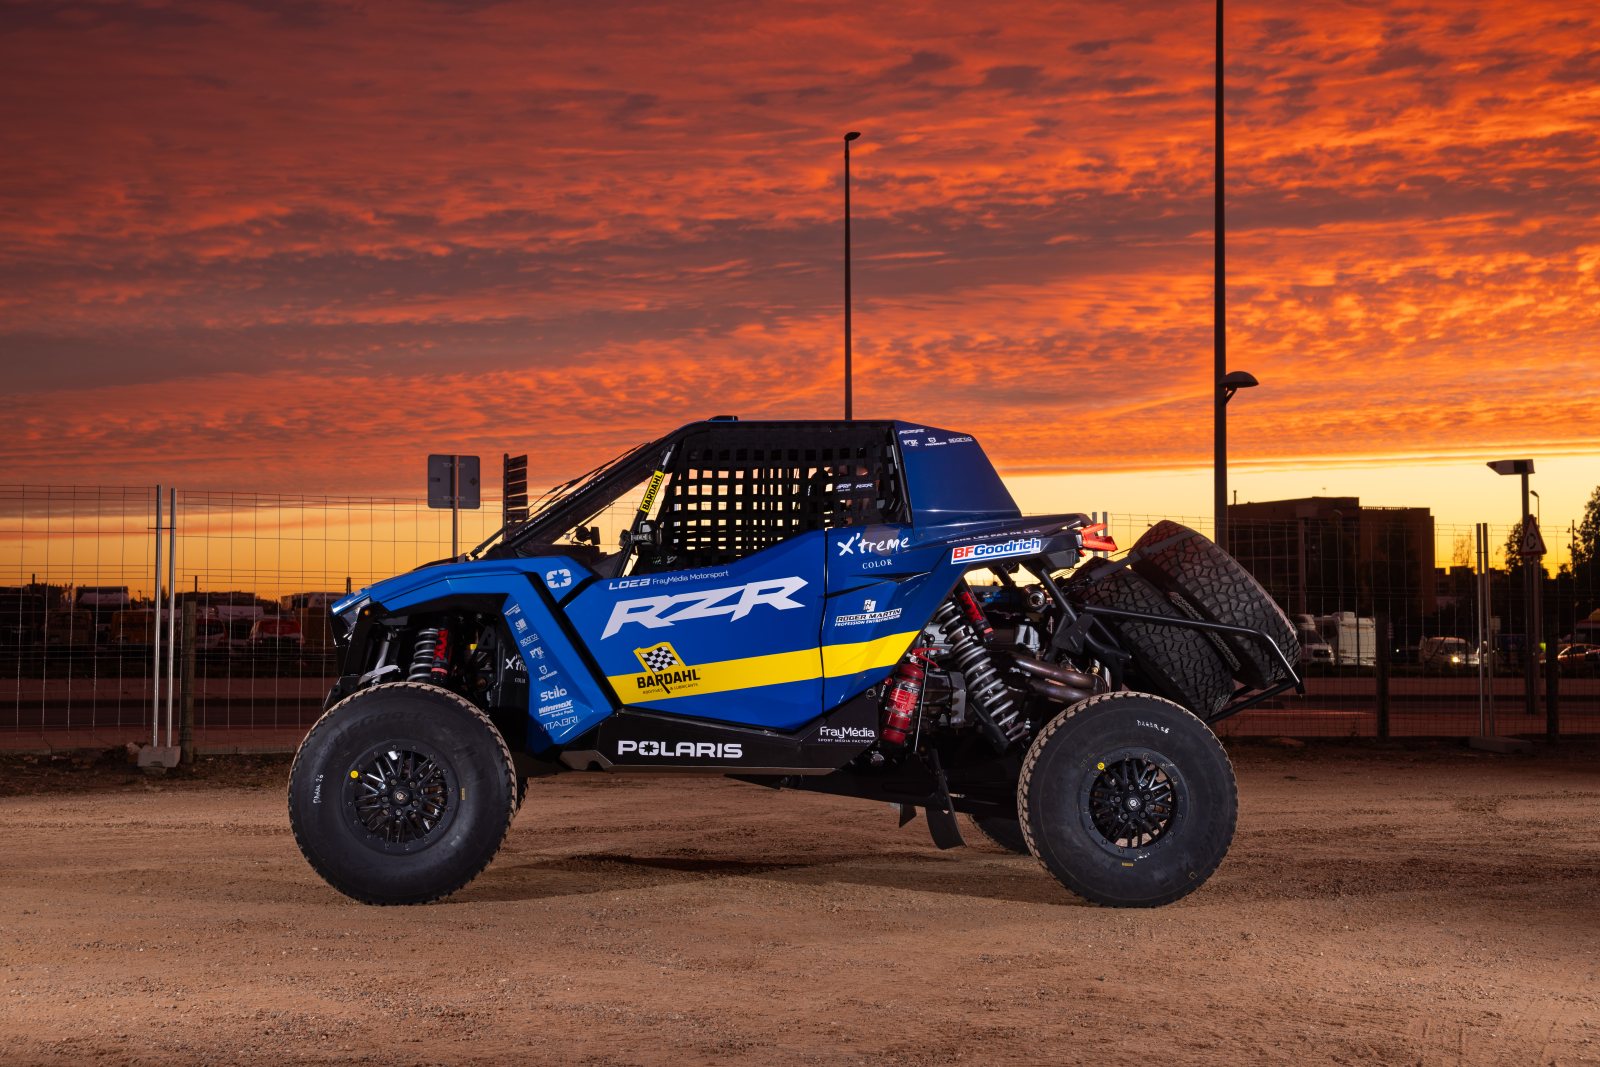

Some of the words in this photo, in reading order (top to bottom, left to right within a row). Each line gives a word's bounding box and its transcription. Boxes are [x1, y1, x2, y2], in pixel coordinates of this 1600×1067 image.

[641, 473, 664, 512] BARDAHL
[837, 532, 911, 556] X'treme
[952, 537, 1042, 560] BFGoodrich
[862, 558, 893, 570] COLOR
[608, 578, 651, 590] LOEB
[689, 569, 729, 581] Motorsport
[600, 575, 809, 641] RZR
[836, 613, 867, 623] ROGER
[868, 608, 902, 620] MARTIN
[636, 668, 702, 689] BARDAHL
[540, 685, 568, 702] Stilo
[819, 726, 876, 739] FrayMédia
[617, 740, 743, 758] POLARIS
